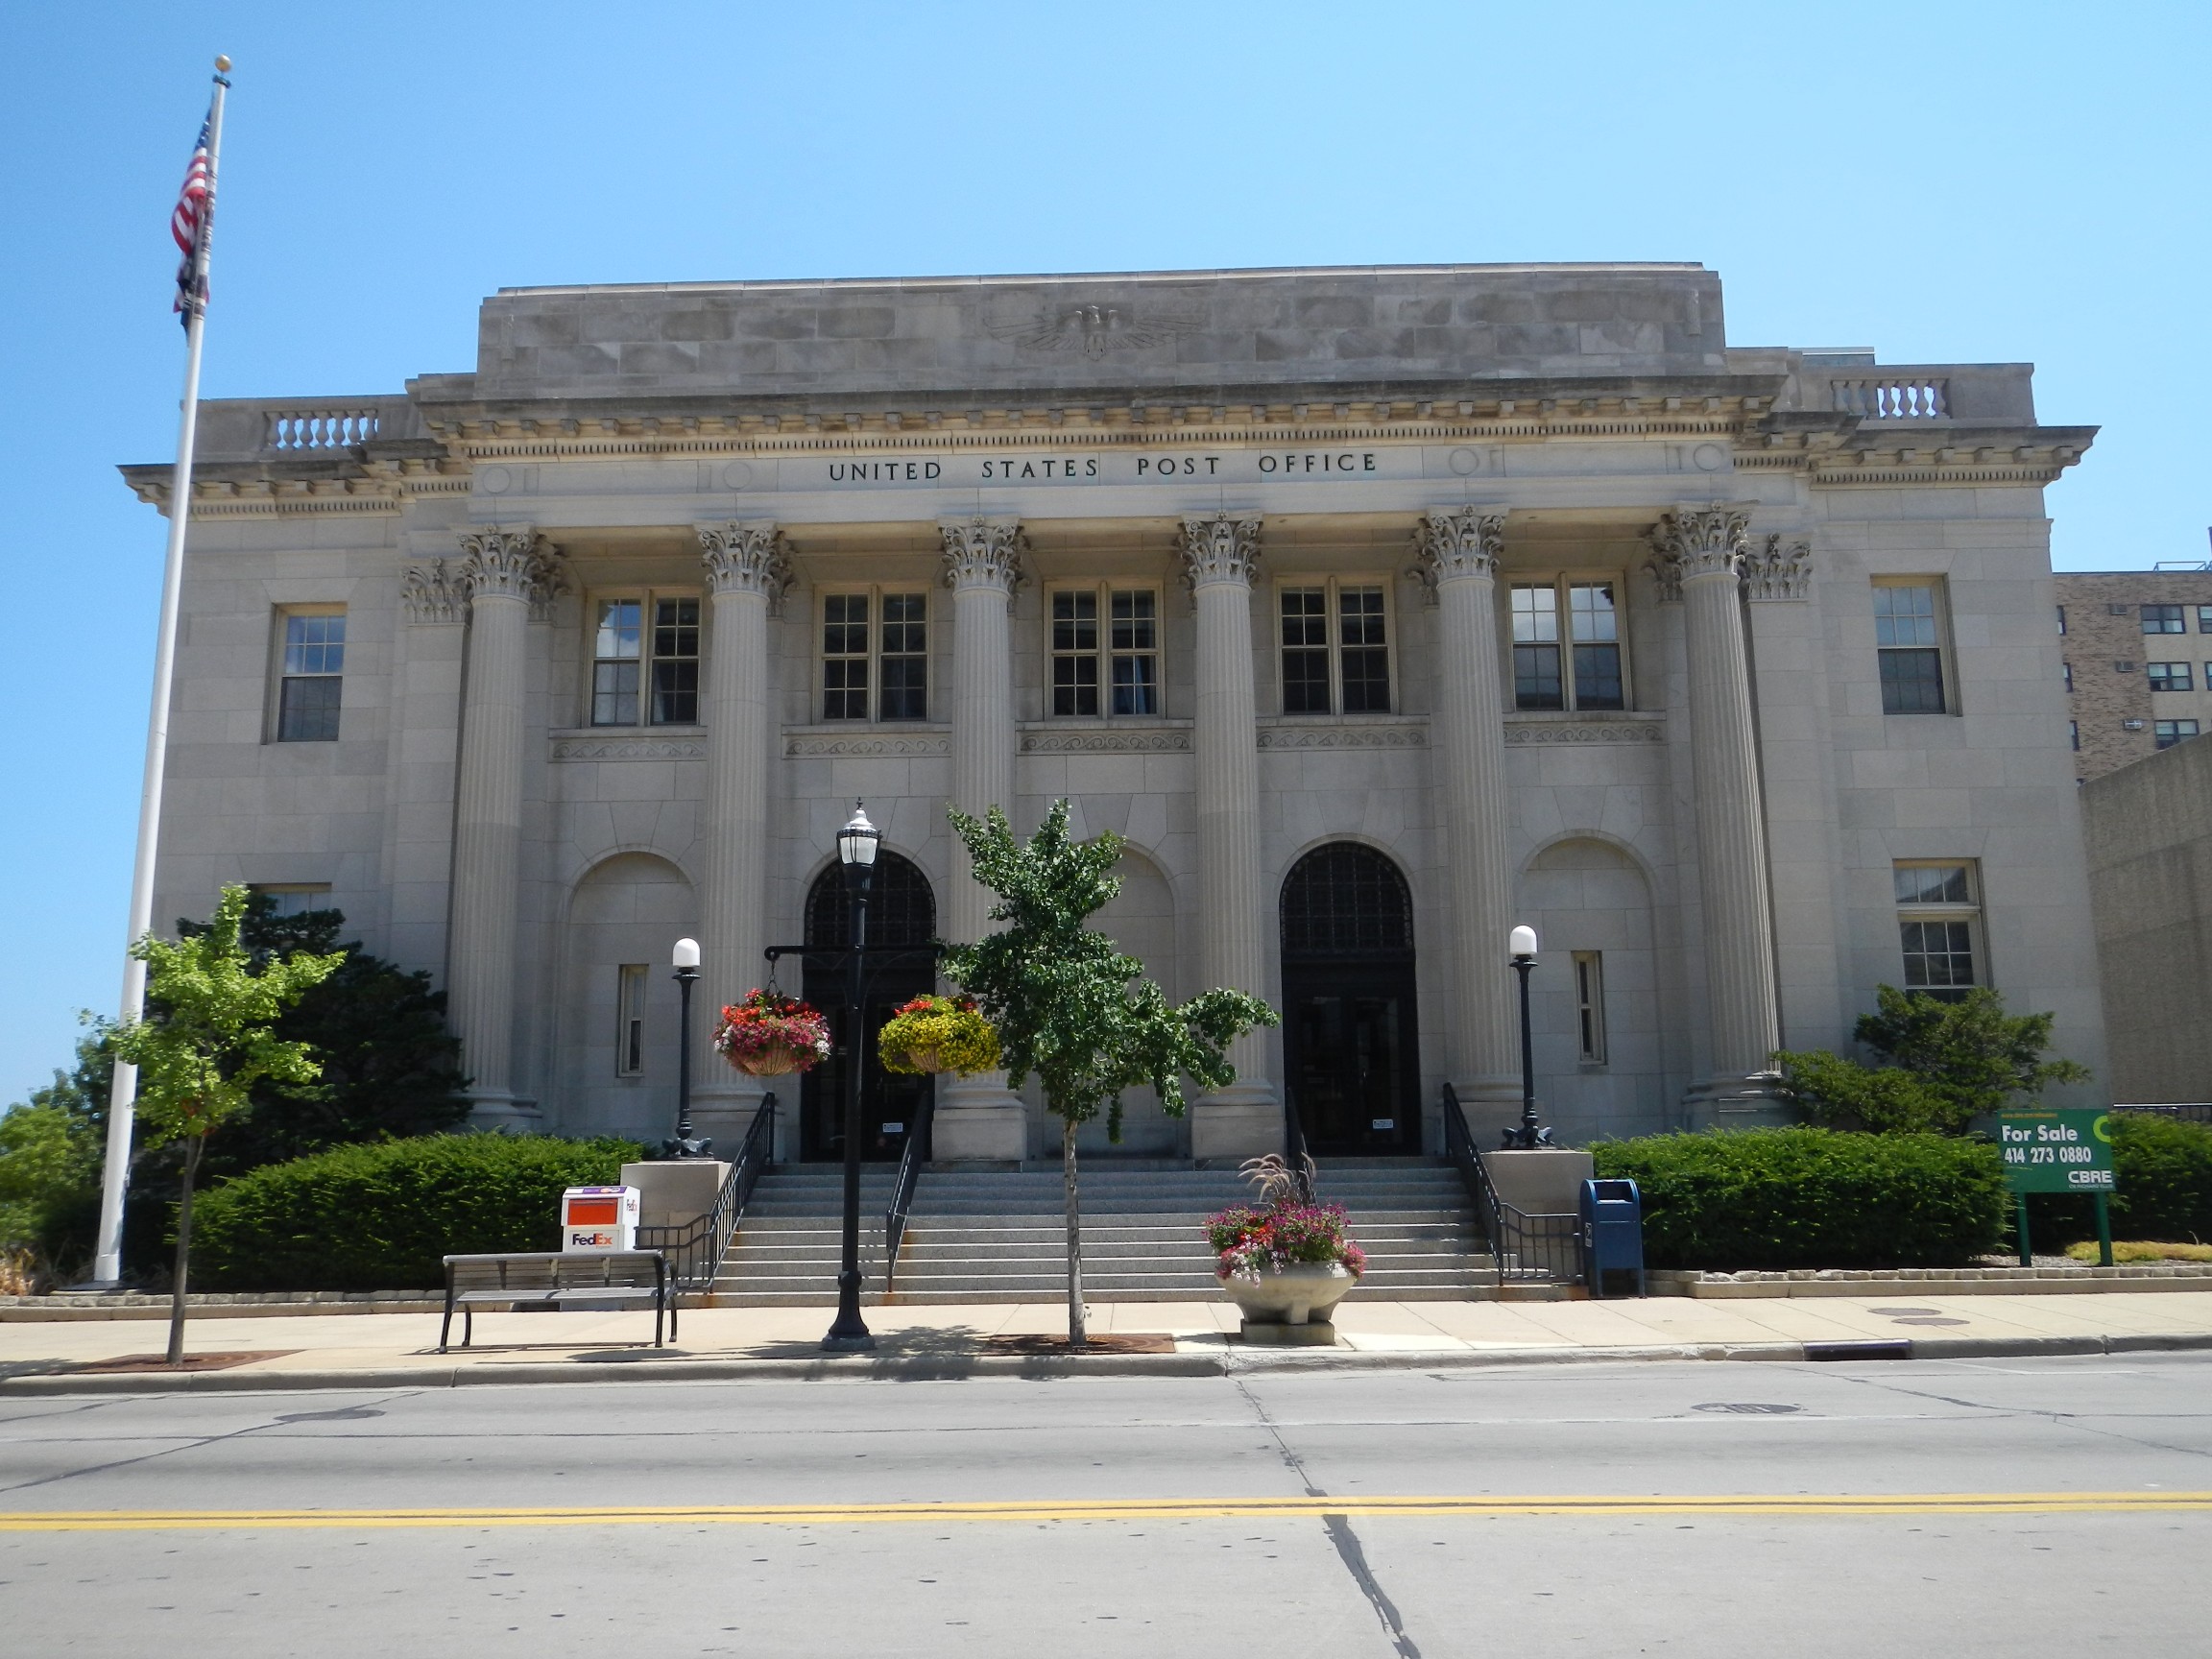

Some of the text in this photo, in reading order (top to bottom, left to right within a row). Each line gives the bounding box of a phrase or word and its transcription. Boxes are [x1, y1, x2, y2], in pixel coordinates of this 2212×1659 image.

[830, 453, 1376, 481] UNITED STATES POST OFFICE
[2002, 1124, 2078, 1142] For Sale
[2005, 1146, 2092, 1163] 414 273 0880
[2068, 1170, 2112, 1184] CBRE
[572, 1233, 613, 1245] FedEx
